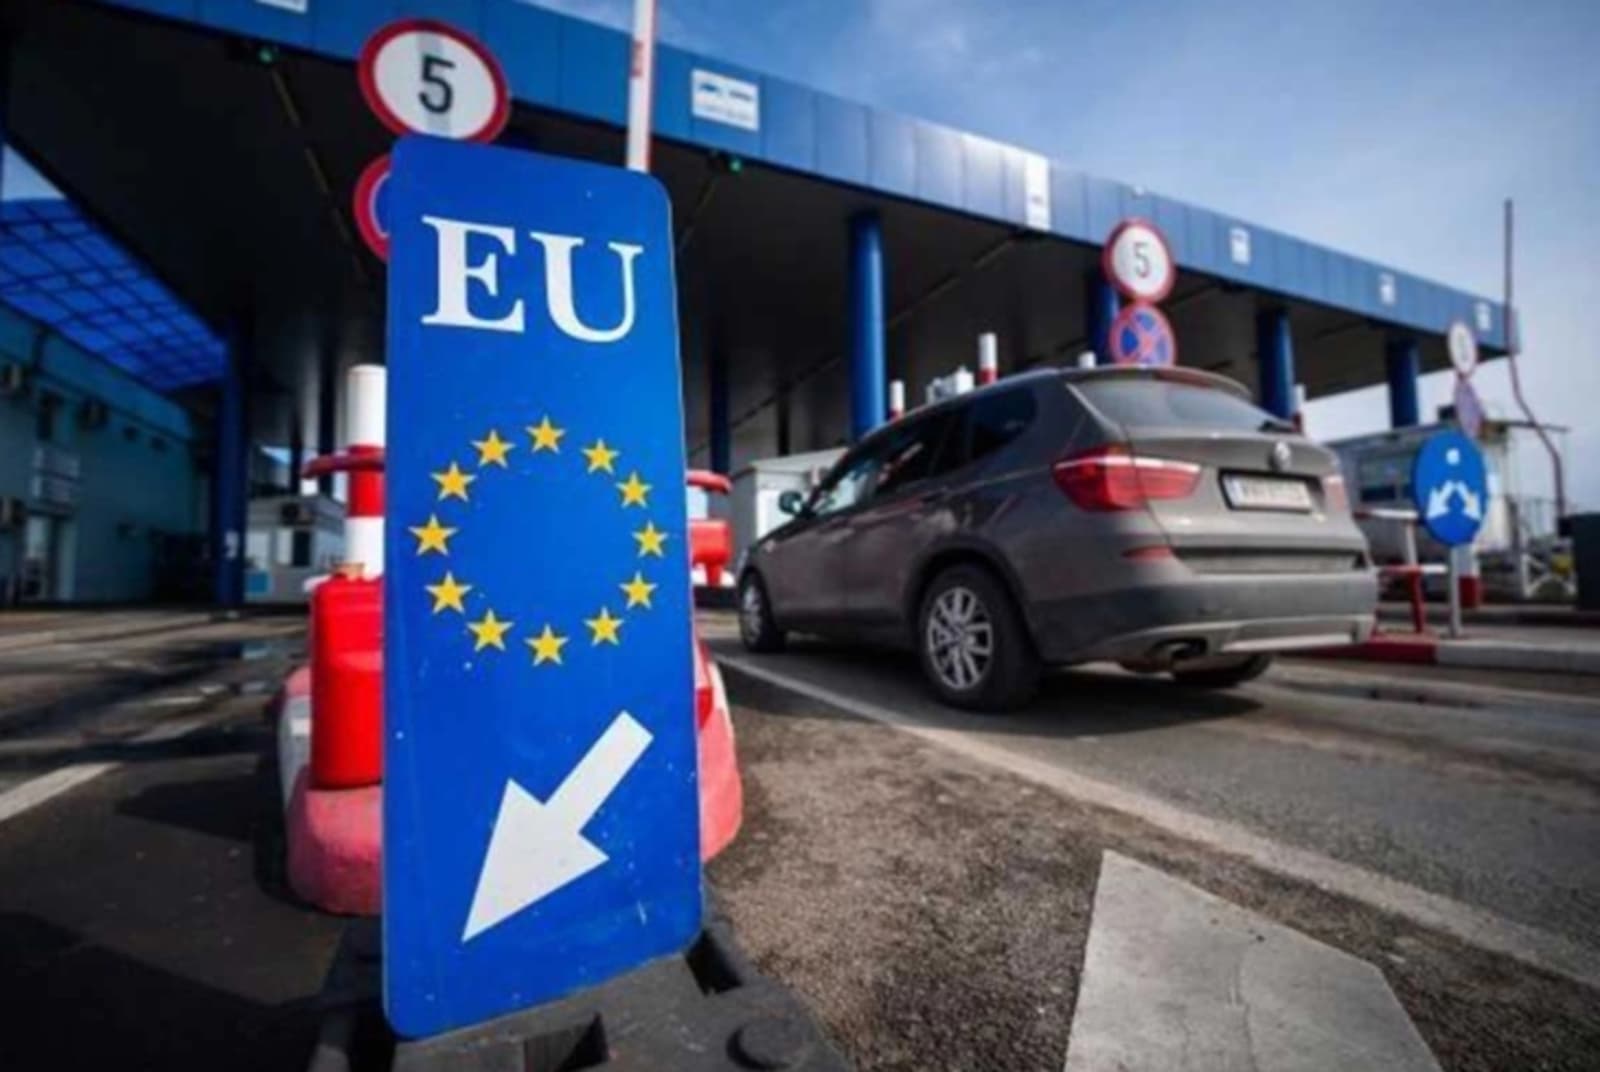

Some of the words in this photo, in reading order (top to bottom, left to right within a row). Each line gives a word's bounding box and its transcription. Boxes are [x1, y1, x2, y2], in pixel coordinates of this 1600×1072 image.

[419, 54, 455, 114] 5
[421, 214, 644, 343] EU
[1133, 241, 1151, 279] 5
